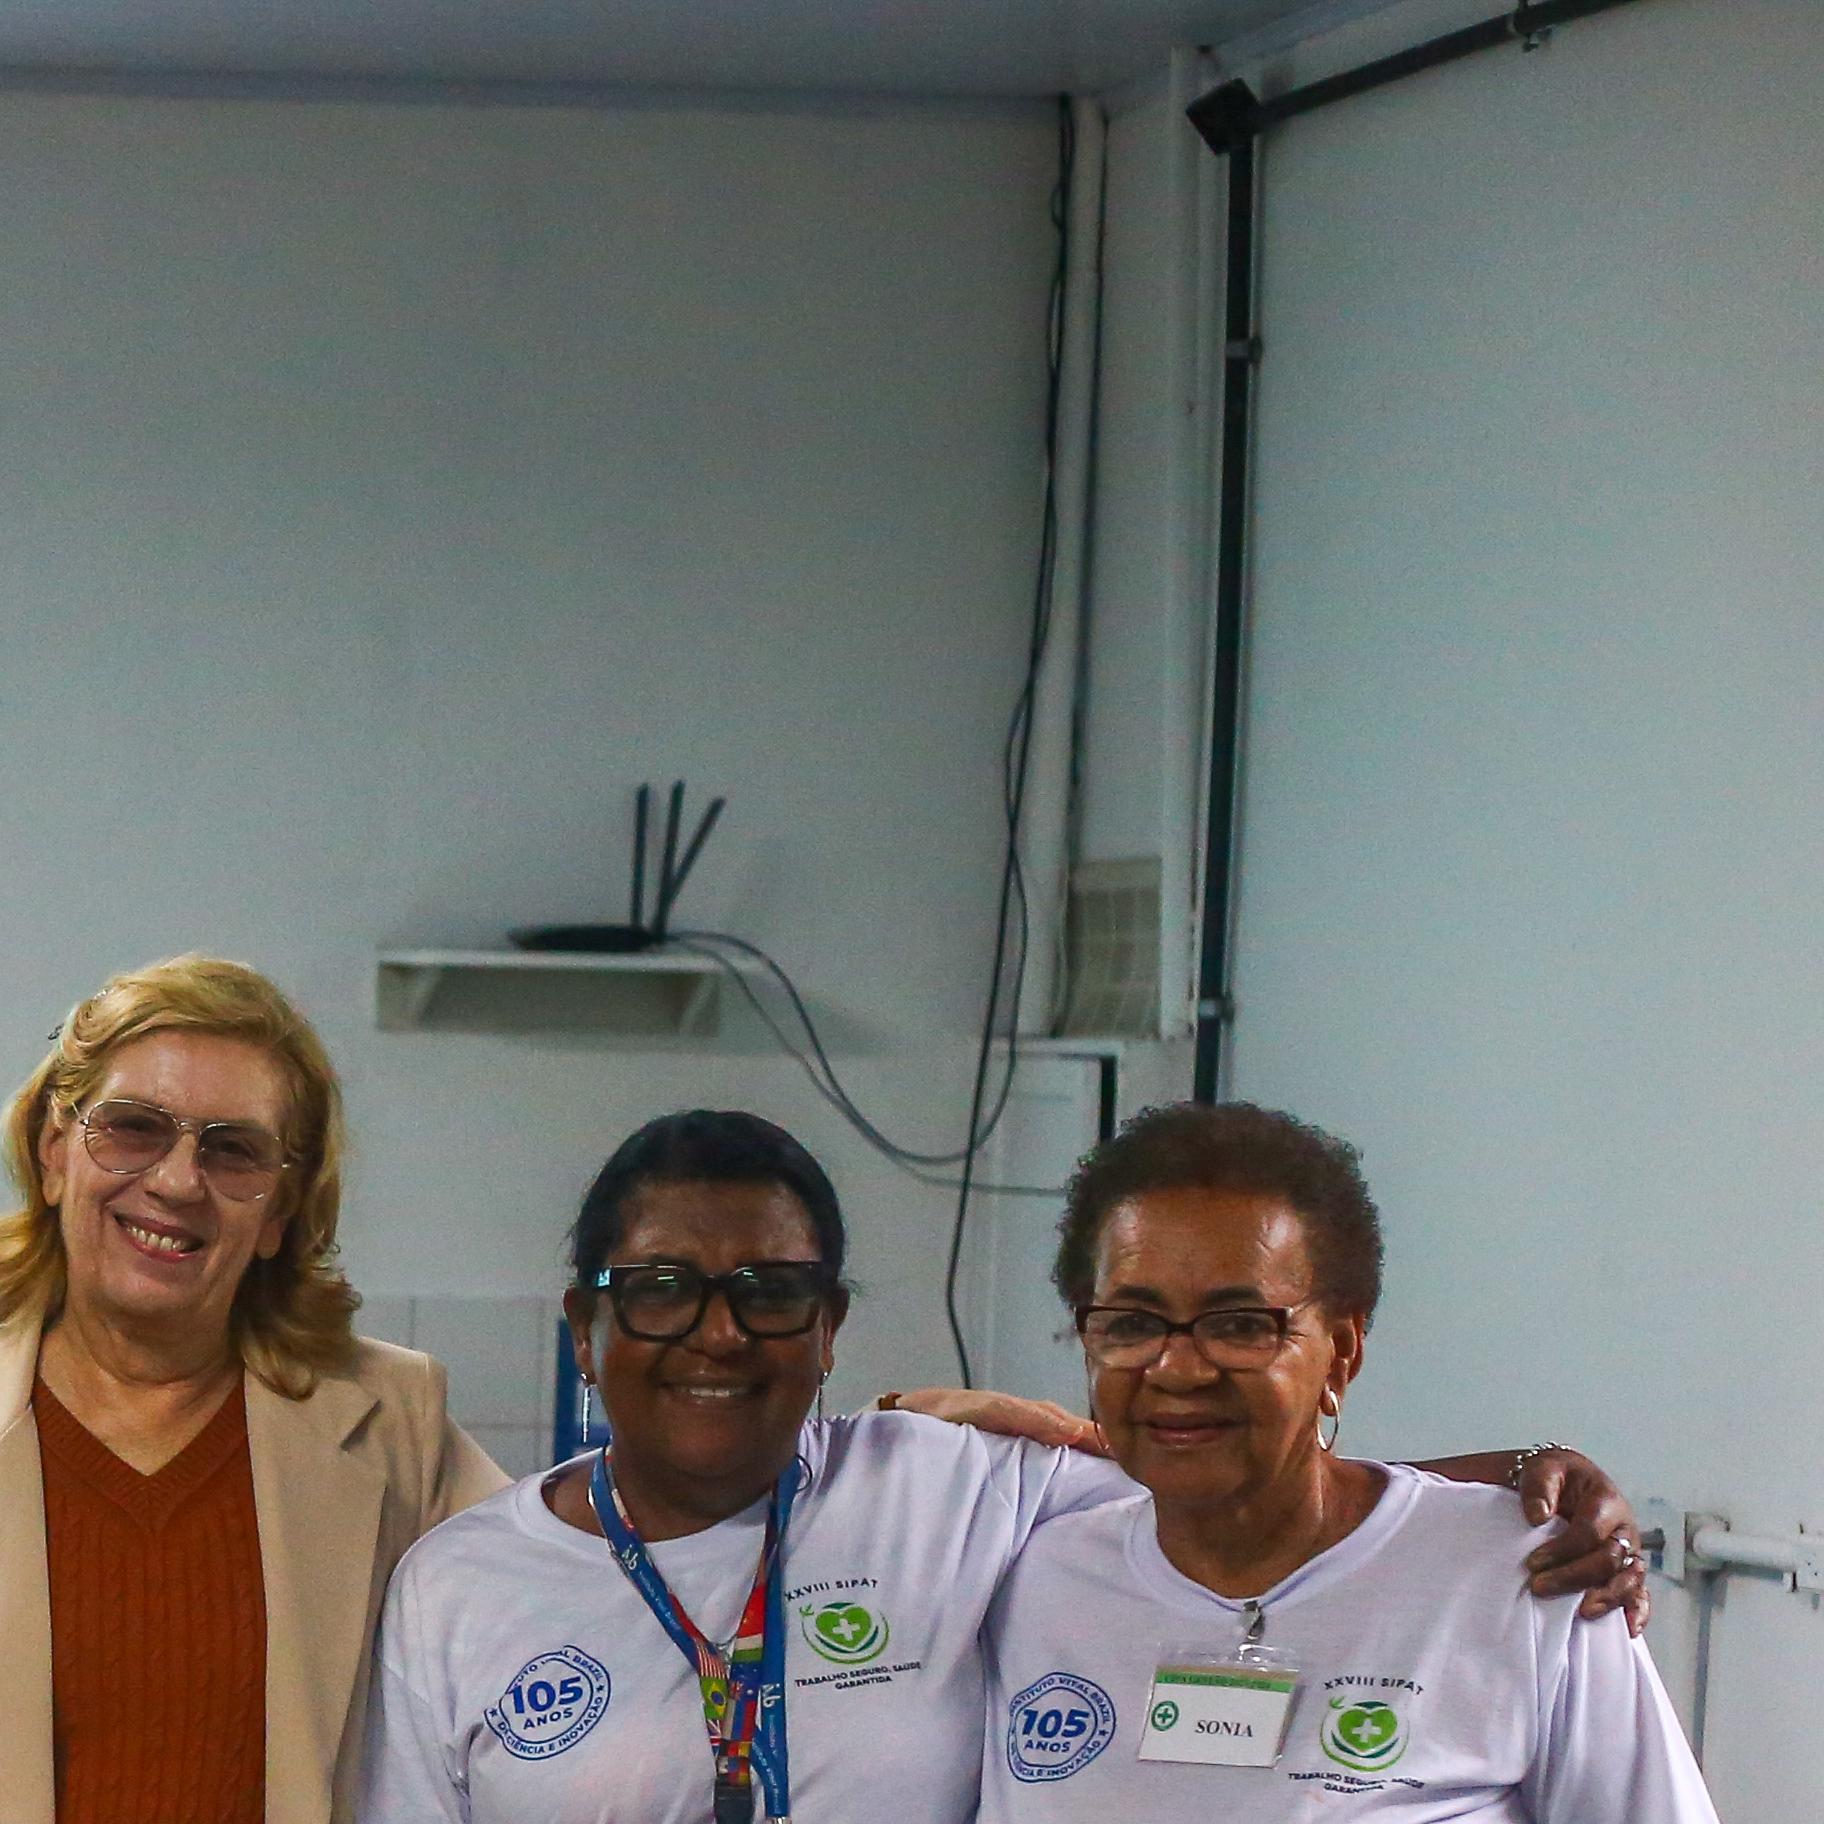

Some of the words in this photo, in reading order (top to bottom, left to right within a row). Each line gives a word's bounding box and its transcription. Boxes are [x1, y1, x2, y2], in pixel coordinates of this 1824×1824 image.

[835, 1577, 878, 1589] SIPAT
[794, 1671, 848, 1688] TRABALHO
[835, 1674, 893, 1690] GARANTIDA
[1323, 1675, 1374, 1690] XXVIII
[1380, 1677, 1425, 1695] SIPAT
[512, 1676, 583, 1714] 105
[523, 1707, 573, 1730] ANOS
[1021, 1708, 1090, 1738] 105
[1194, 1719, 1254, 1739] SONIA
[1024, 1738, 1071, 1753] ANOS
